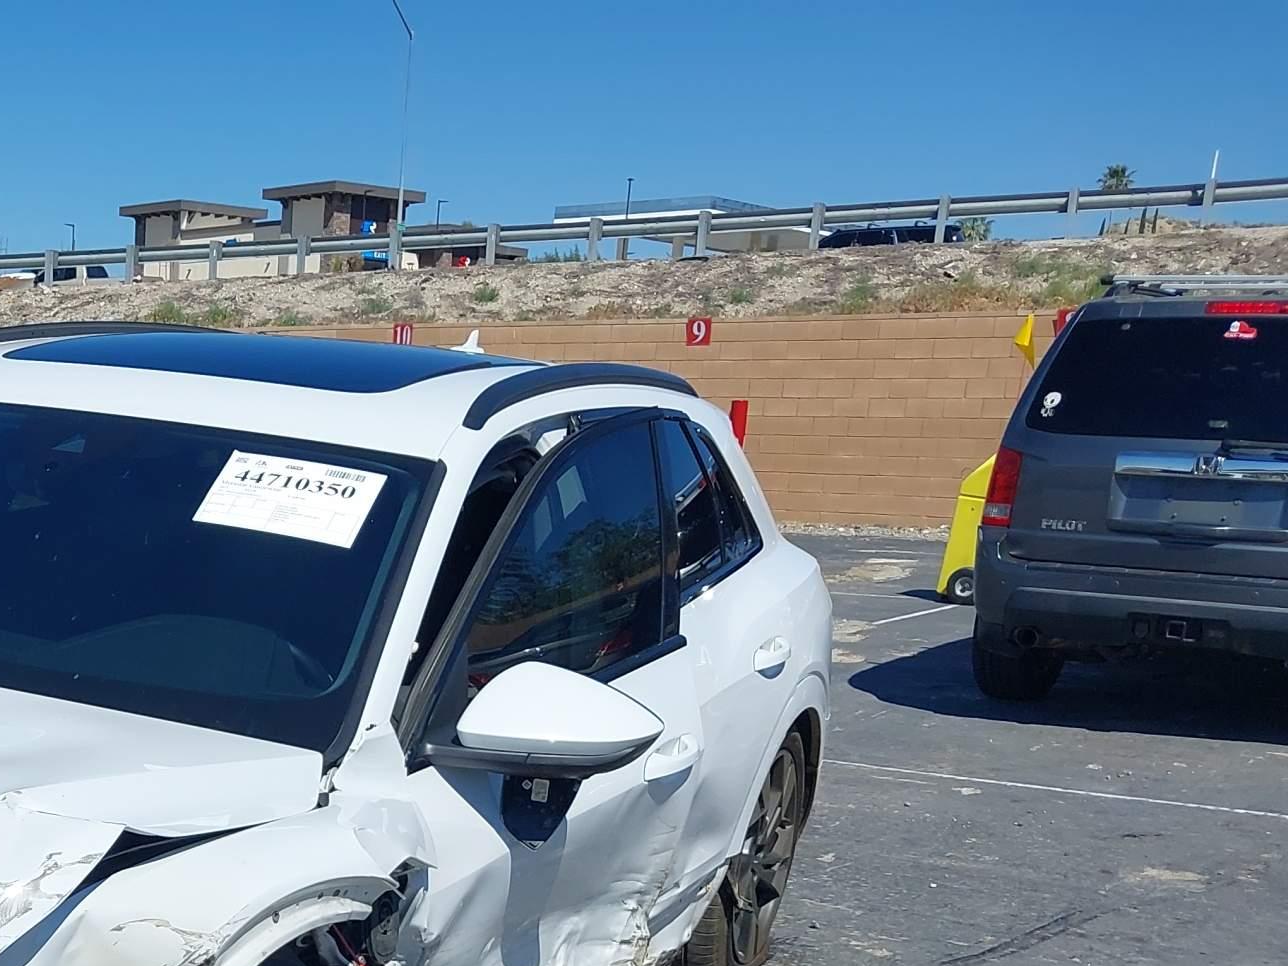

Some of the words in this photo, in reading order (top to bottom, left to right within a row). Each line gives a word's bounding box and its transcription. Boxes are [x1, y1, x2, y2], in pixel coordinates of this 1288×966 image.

[395, 325, 411, 345] 10
[692, 320, 706, 344] 9
[234, 469, 356, 499] 44710350
[1041, 518, 1087, 532] PILOT
